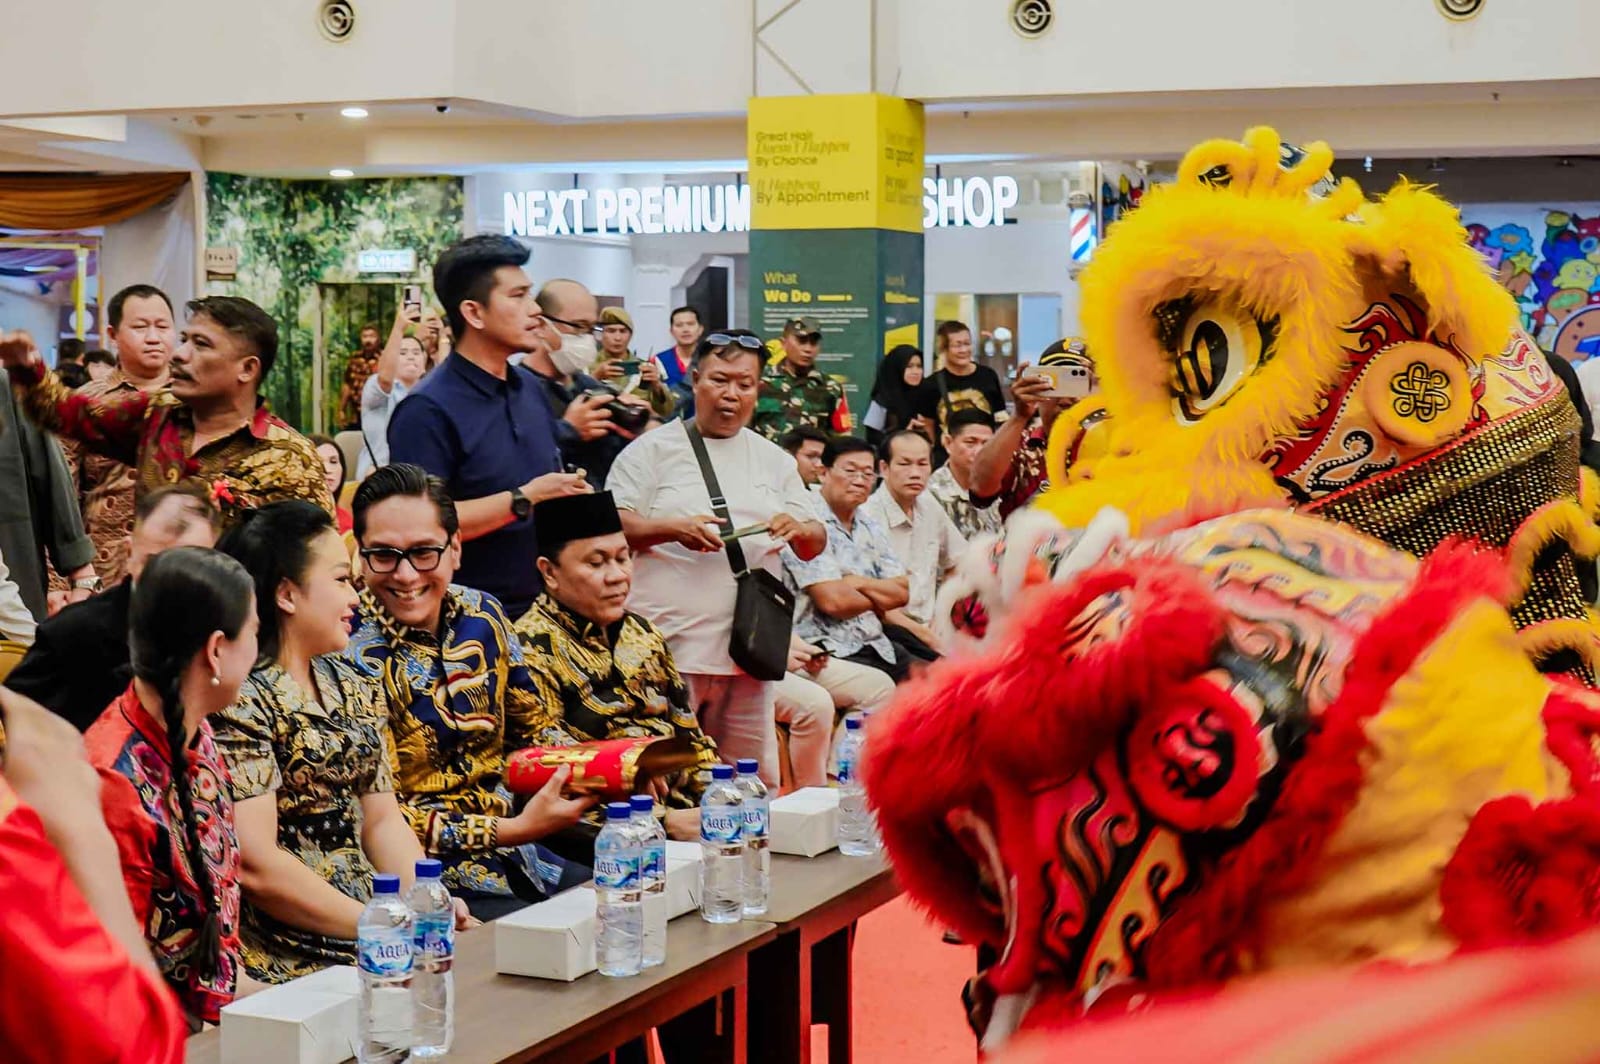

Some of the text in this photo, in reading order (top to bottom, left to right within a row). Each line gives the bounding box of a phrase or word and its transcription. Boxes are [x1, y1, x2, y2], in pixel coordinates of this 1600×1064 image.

[755, 131, 788, 143] Great
[755, 154, 818, 168] By Chance
[757, 191, 773, 205] By
[777, 189, 870, 207] Appointment
[503, 188, 589, 237] NEXT
[596, 184, 750, 235] PREMIUM
[764, 271, 798, 285] What
[764, 289, 812, 303] We Do
[705, 817, 734, 831] AQUA
[375, 943, 410, 960] AQUA
